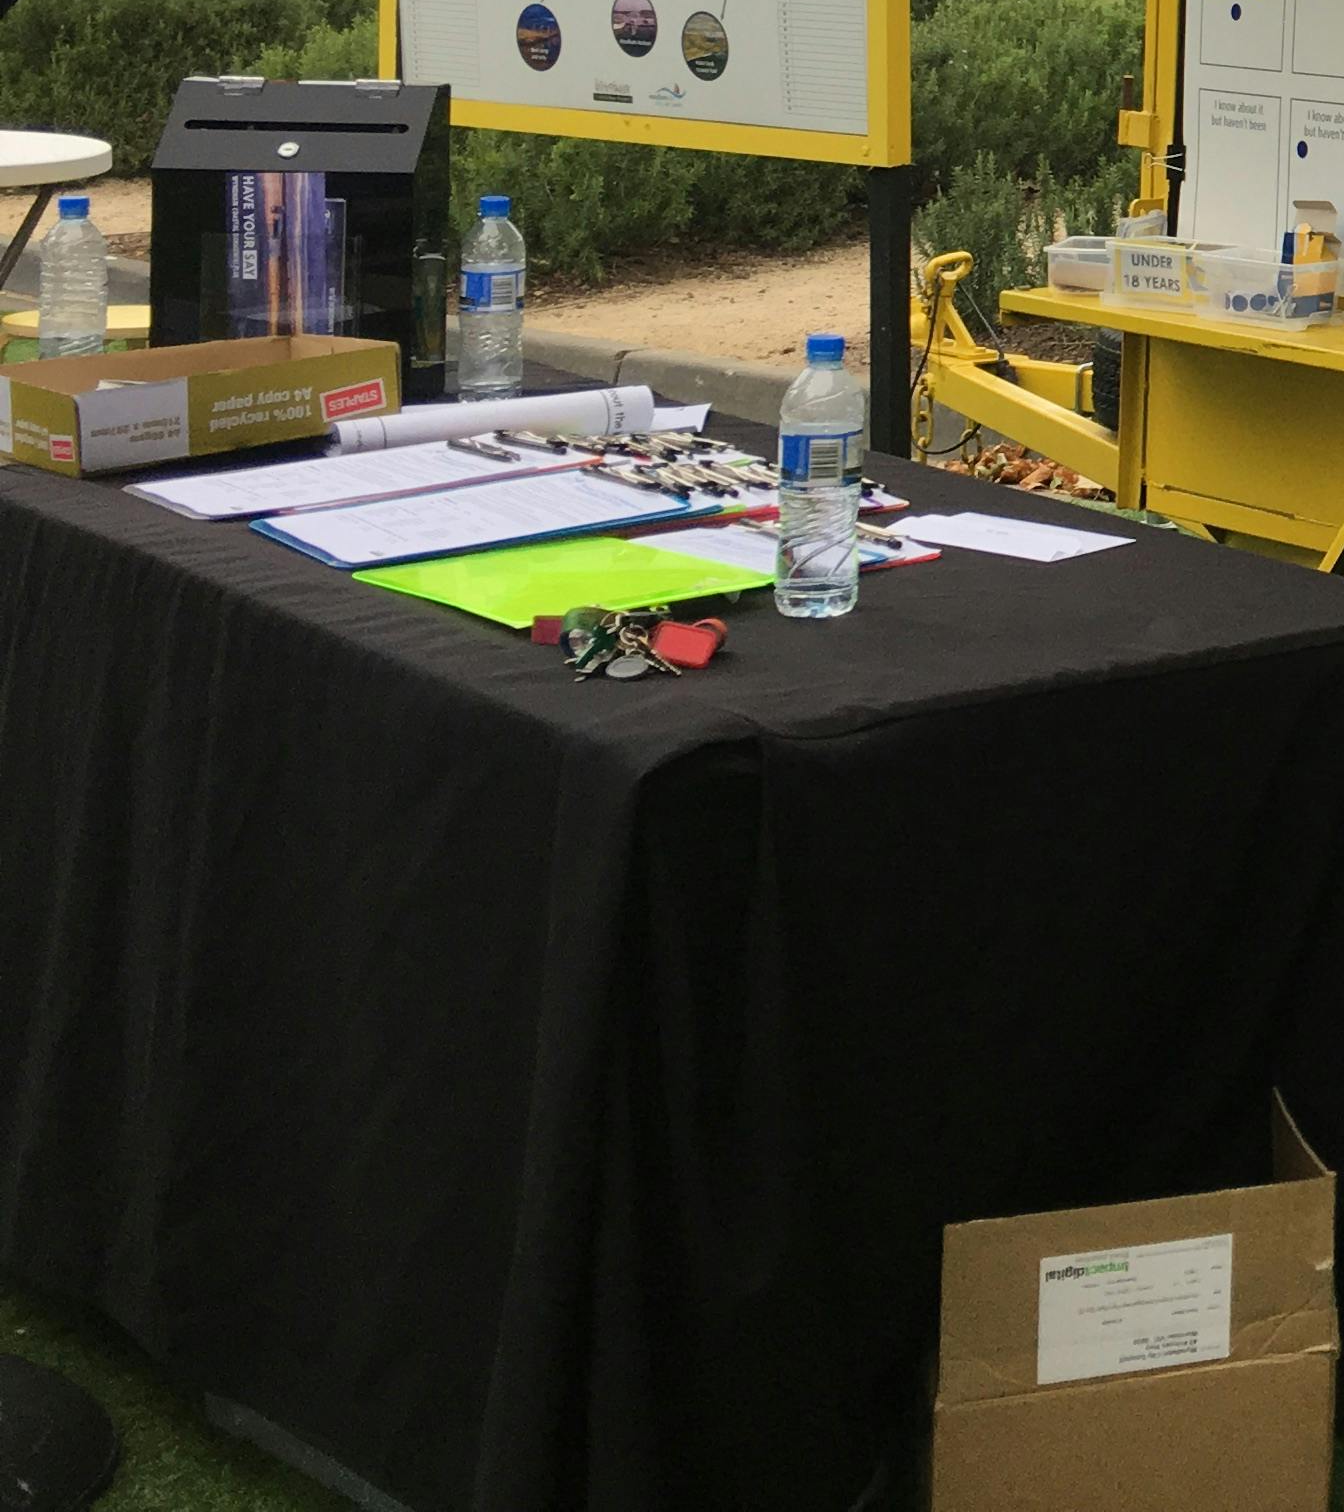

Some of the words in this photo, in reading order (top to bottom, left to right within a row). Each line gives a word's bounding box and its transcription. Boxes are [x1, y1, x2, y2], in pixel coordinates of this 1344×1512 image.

[242, 176, 255, 210] HAVE
[242, 213, 255, 249] YOUR
[244, 254, 256, 279] SAY
[1131, 253, 1173, 269] UNDER
[1124, 274, 1140, 288] 18
[1143, 275, 1180, 292] YEARS
[257, 389, 290, 405] copy
[328, 390, 378, 412] STAPLES
